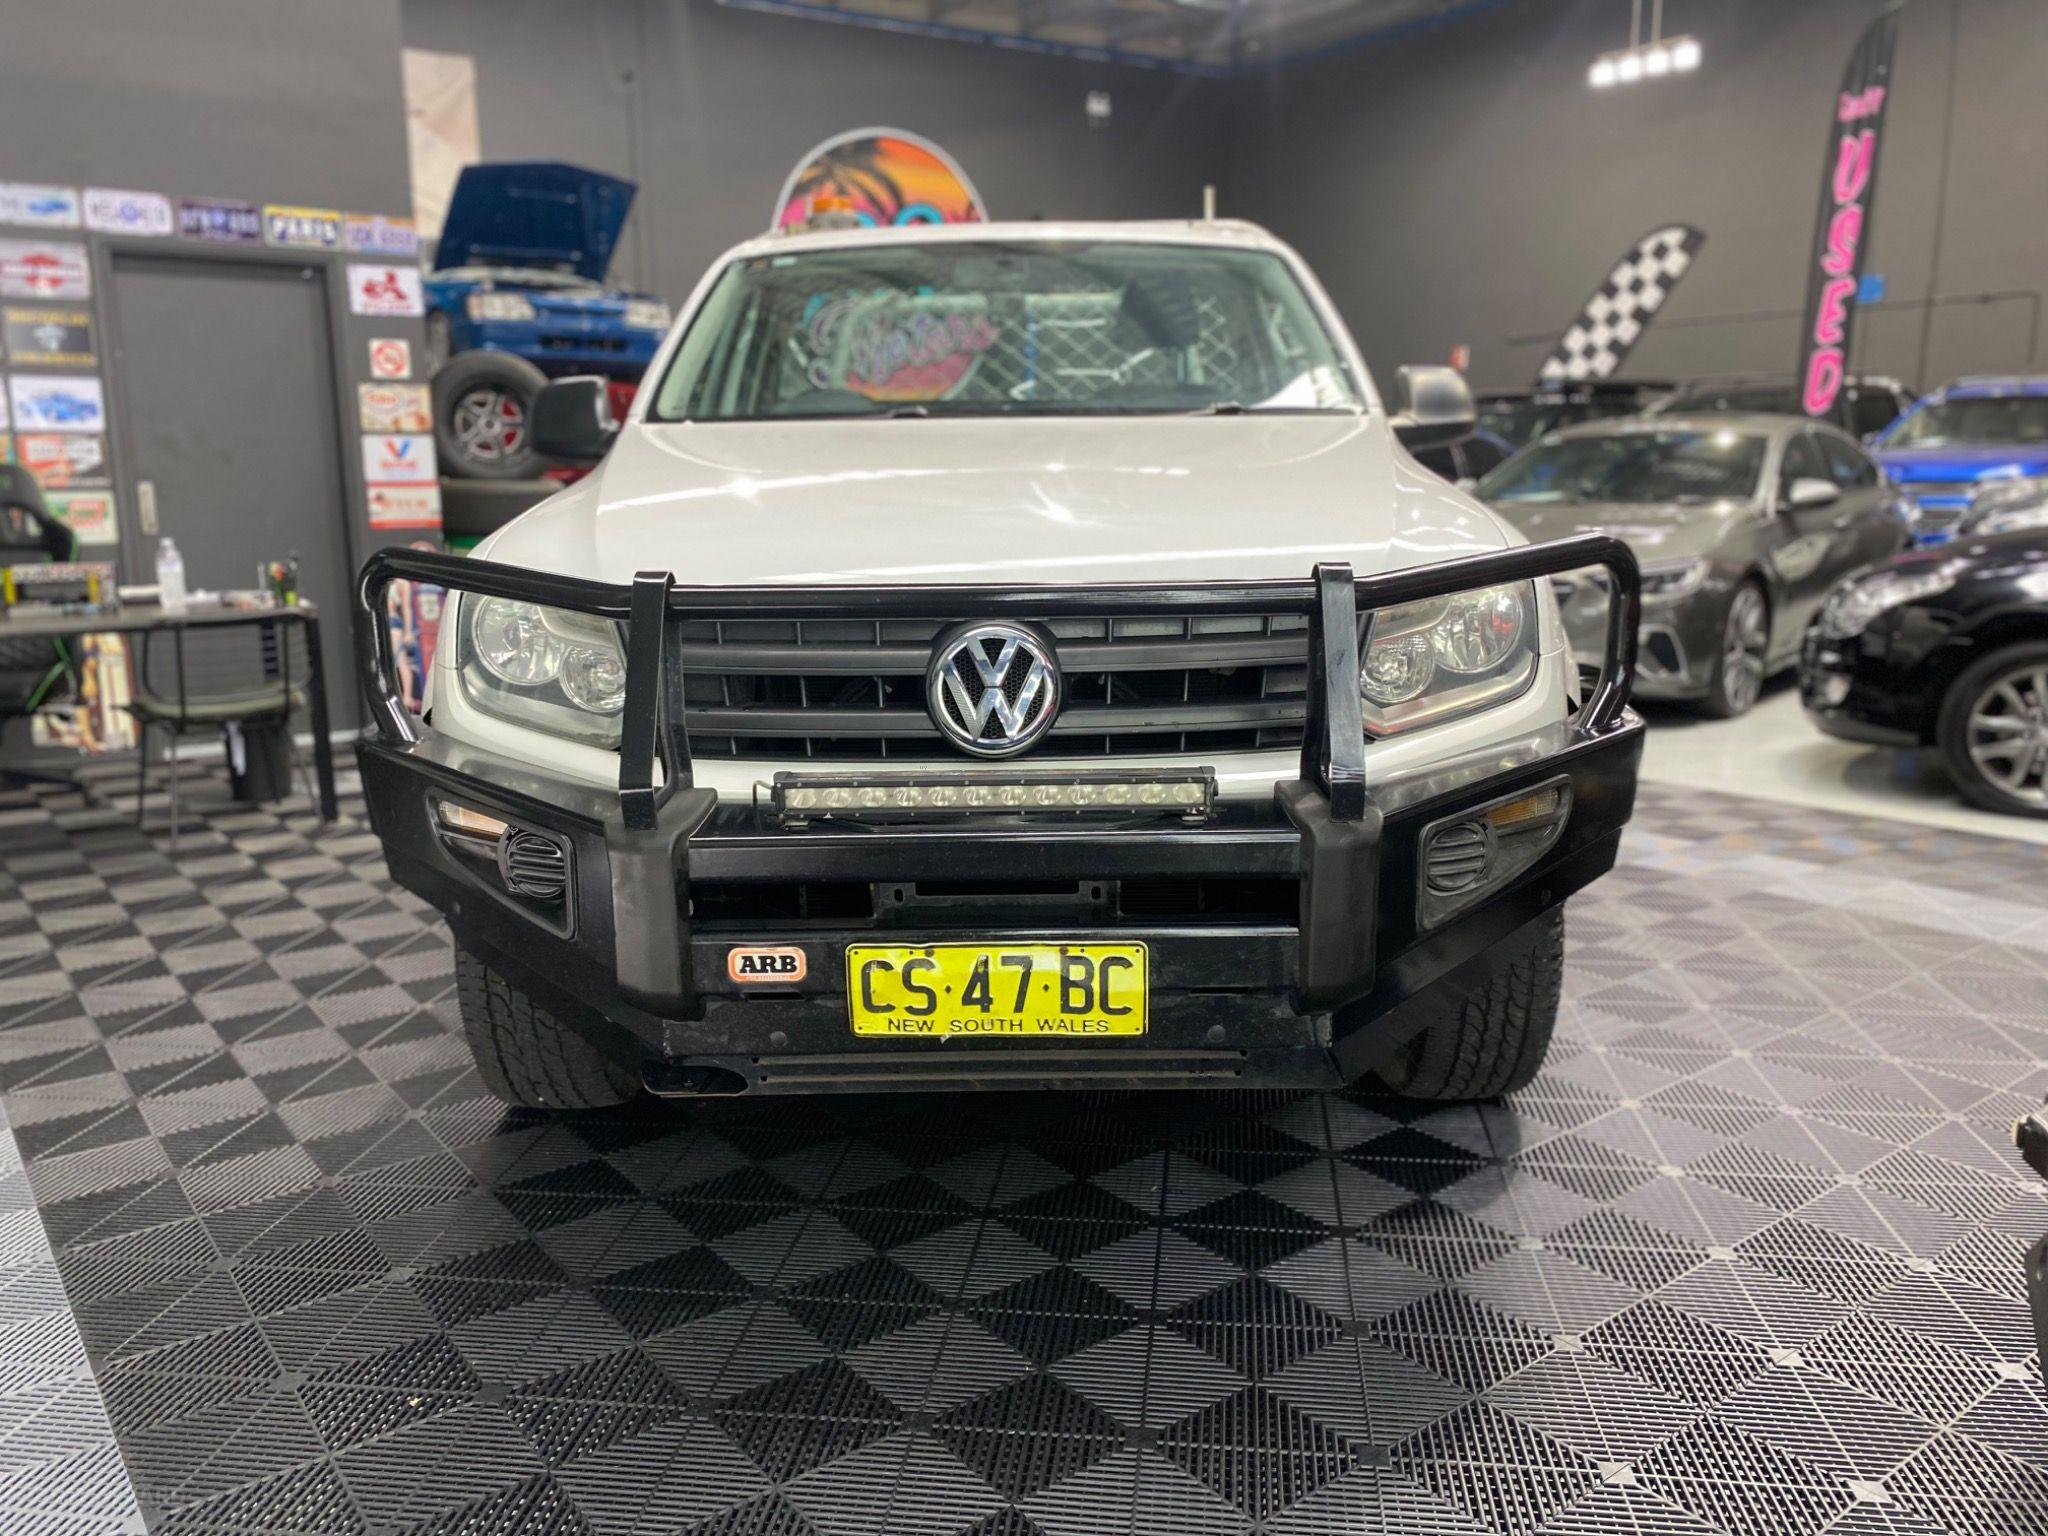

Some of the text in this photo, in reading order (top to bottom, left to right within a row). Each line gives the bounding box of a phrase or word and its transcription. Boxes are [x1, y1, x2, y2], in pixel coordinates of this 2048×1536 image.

[1803, 128, 1875, 416] USED
[739, 955, 797, 974] ARB
[888, 1018, 1109, 1033] NEW SOUTH WALES
